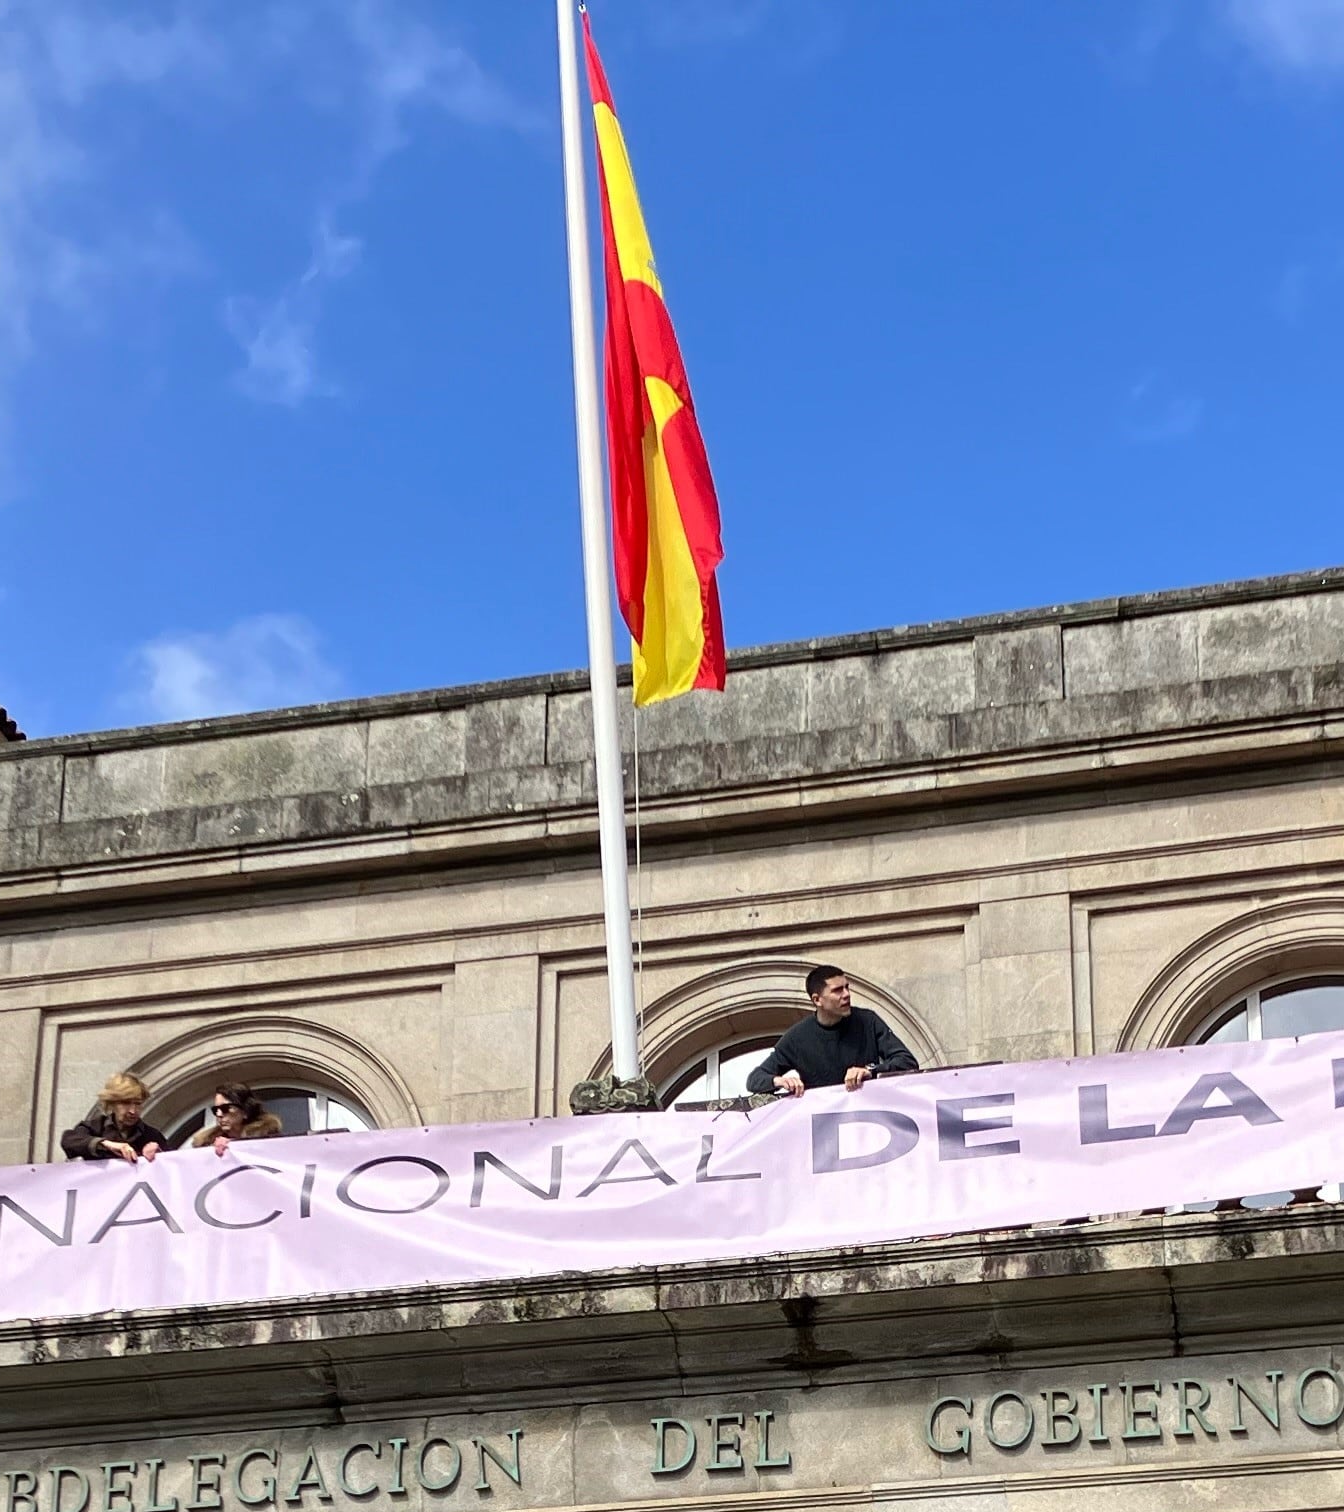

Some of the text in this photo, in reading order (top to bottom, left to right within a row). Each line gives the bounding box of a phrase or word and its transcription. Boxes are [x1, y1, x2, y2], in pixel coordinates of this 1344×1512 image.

[812, 1093, 1021, 1175] DE
[1078, 1071, 1284, 1145] LA
[650, 1410, 791, 1475] DEL
